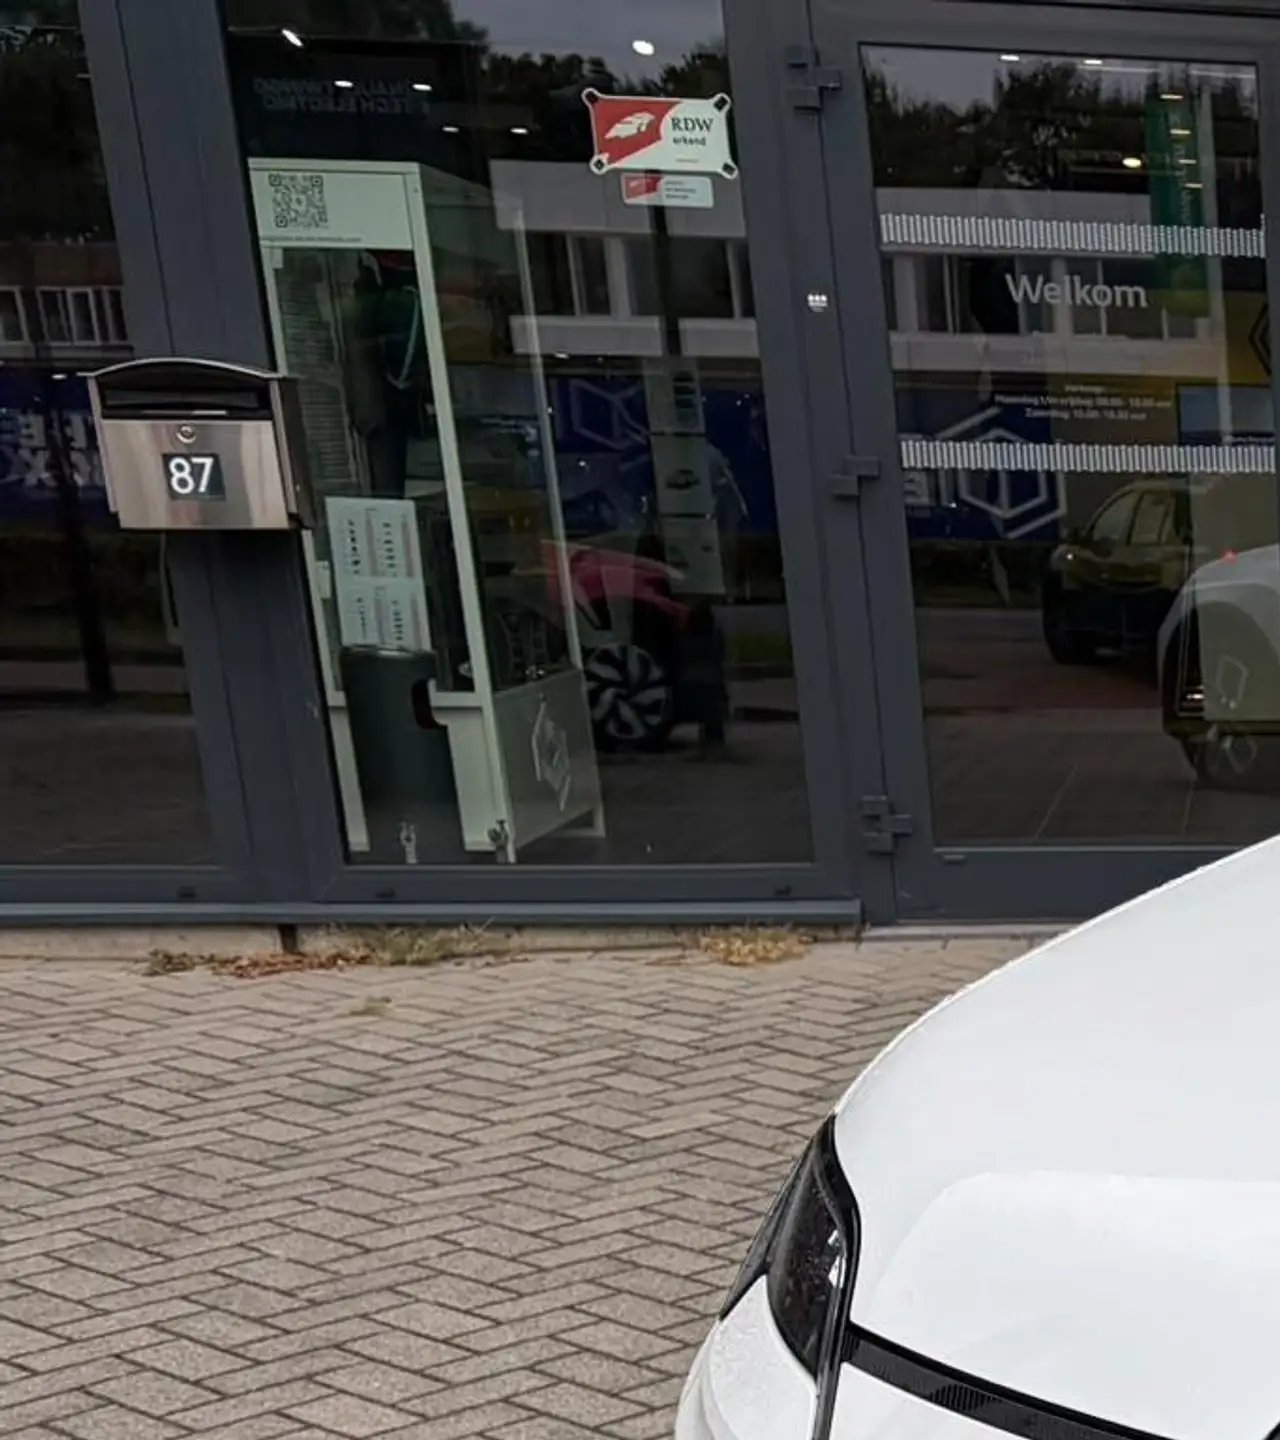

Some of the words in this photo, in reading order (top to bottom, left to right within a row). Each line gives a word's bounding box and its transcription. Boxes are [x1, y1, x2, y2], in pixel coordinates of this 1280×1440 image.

[671, 117, 714, 133] RDW
[1005, 273, 1148, 308] Welkom
[169, 457, 214, 495] 87
